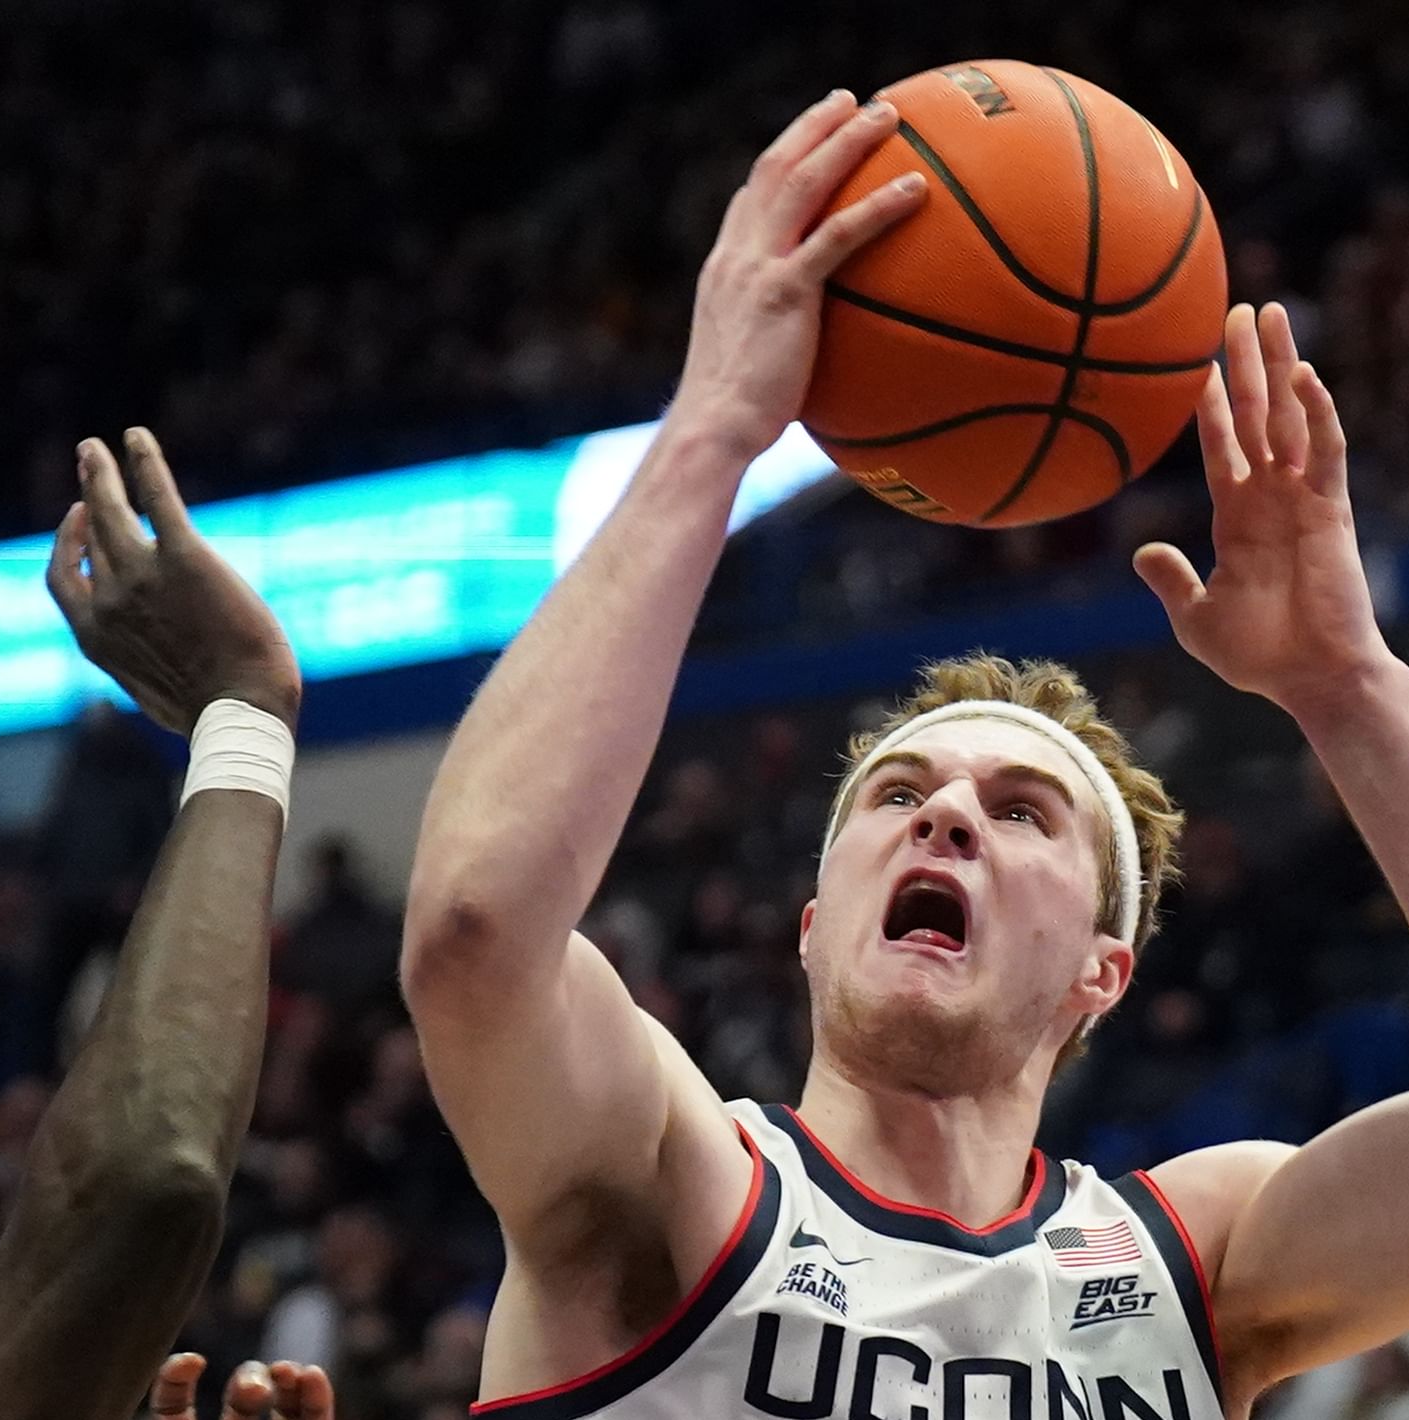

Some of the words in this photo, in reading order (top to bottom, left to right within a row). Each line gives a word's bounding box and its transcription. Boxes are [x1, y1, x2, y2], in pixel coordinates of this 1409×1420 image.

[776, 1277, 849, 1318] CHANGE
[788, 1263, 816, 1278] BE
[822, 1267, 848, 1301] THE
[1079, 1274, 1139, 1299] BIG
[1073, 1292, 1158, 1319] EAST
